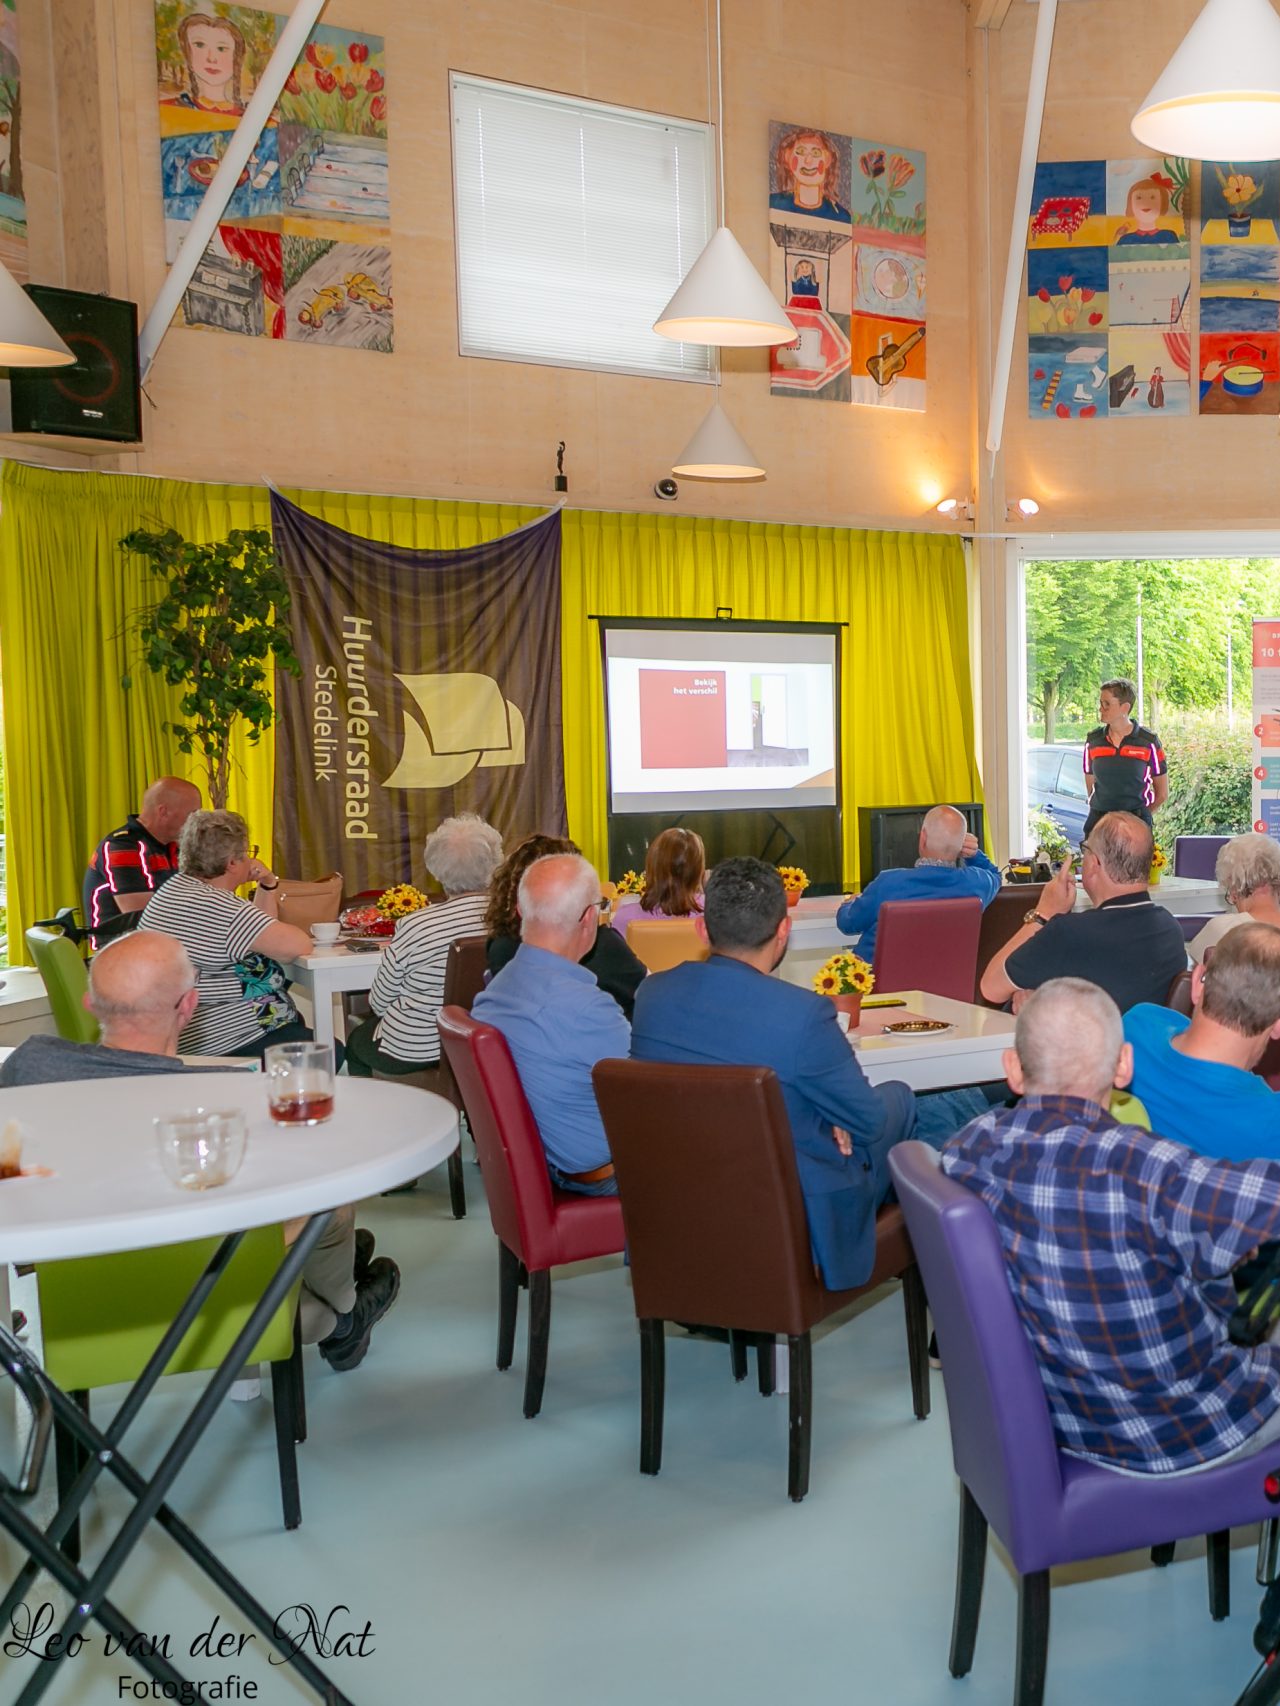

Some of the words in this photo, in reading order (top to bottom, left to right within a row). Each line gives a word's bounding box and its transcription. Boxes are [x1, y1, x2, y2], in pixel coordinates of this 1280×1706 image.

[1261, 648, 1274, 657] 10
[694, 679, 717, 687] Bekijk
[673, 687, 687, 695] het
[689, 687, 718, 695] verschil
[313, 664, 338, 783] Stedelink
[342, 615, 379, 839] Huurdersraad
[1258, 769, 1264, 777] 4
[1258, 823, 1264, 831] 6
